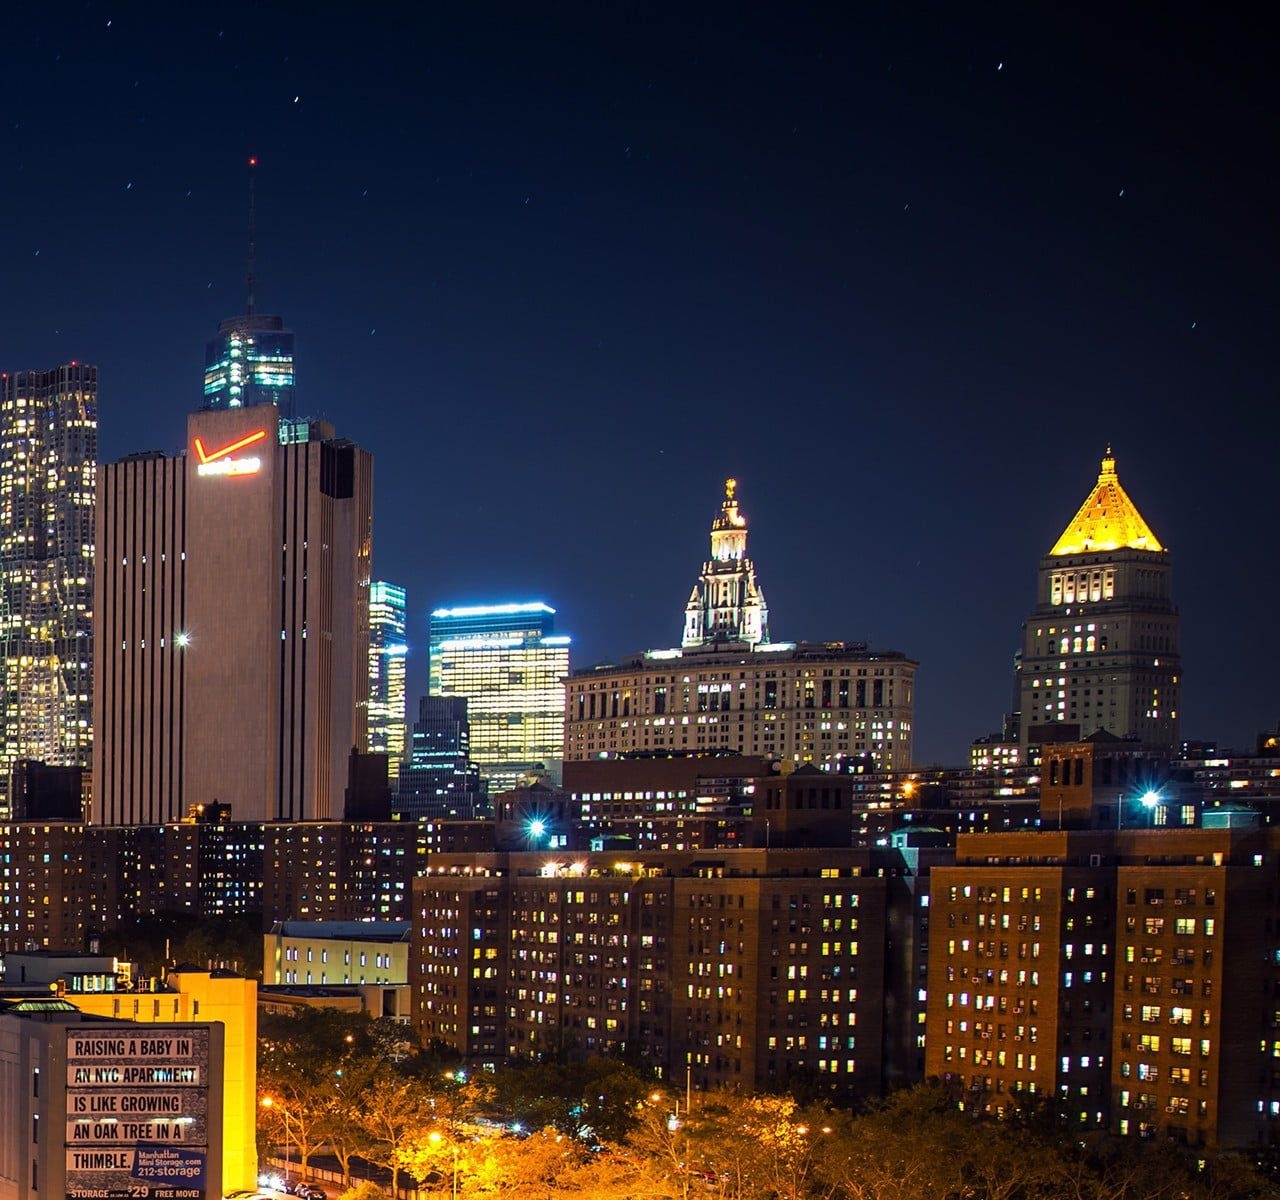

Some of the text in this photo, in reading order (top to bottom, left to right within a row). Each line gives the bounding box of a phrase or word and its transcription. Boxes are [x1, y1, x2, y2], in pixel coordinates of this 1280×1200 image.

[75, 1040, 189, 1056] RAISING A BABY IN
[74, 1067, 196, 1083] AN NYC APARTMENT
[74, 1096, 179, 1112] IS LIKE GROWING
[73, 1123, 181, 1139] AN OAK TREE IN A
[73, 1153, 131, 1168] THIMBLE.
[138, 1149, 180, 1159] Manhattan
[71, 1189, 109, 1198] STORAGE
[127, 1185, 149, 1198] $29
[154, 1190, 174, 1198] FREE
[175, 1190, 200, 1198] MOVE!
